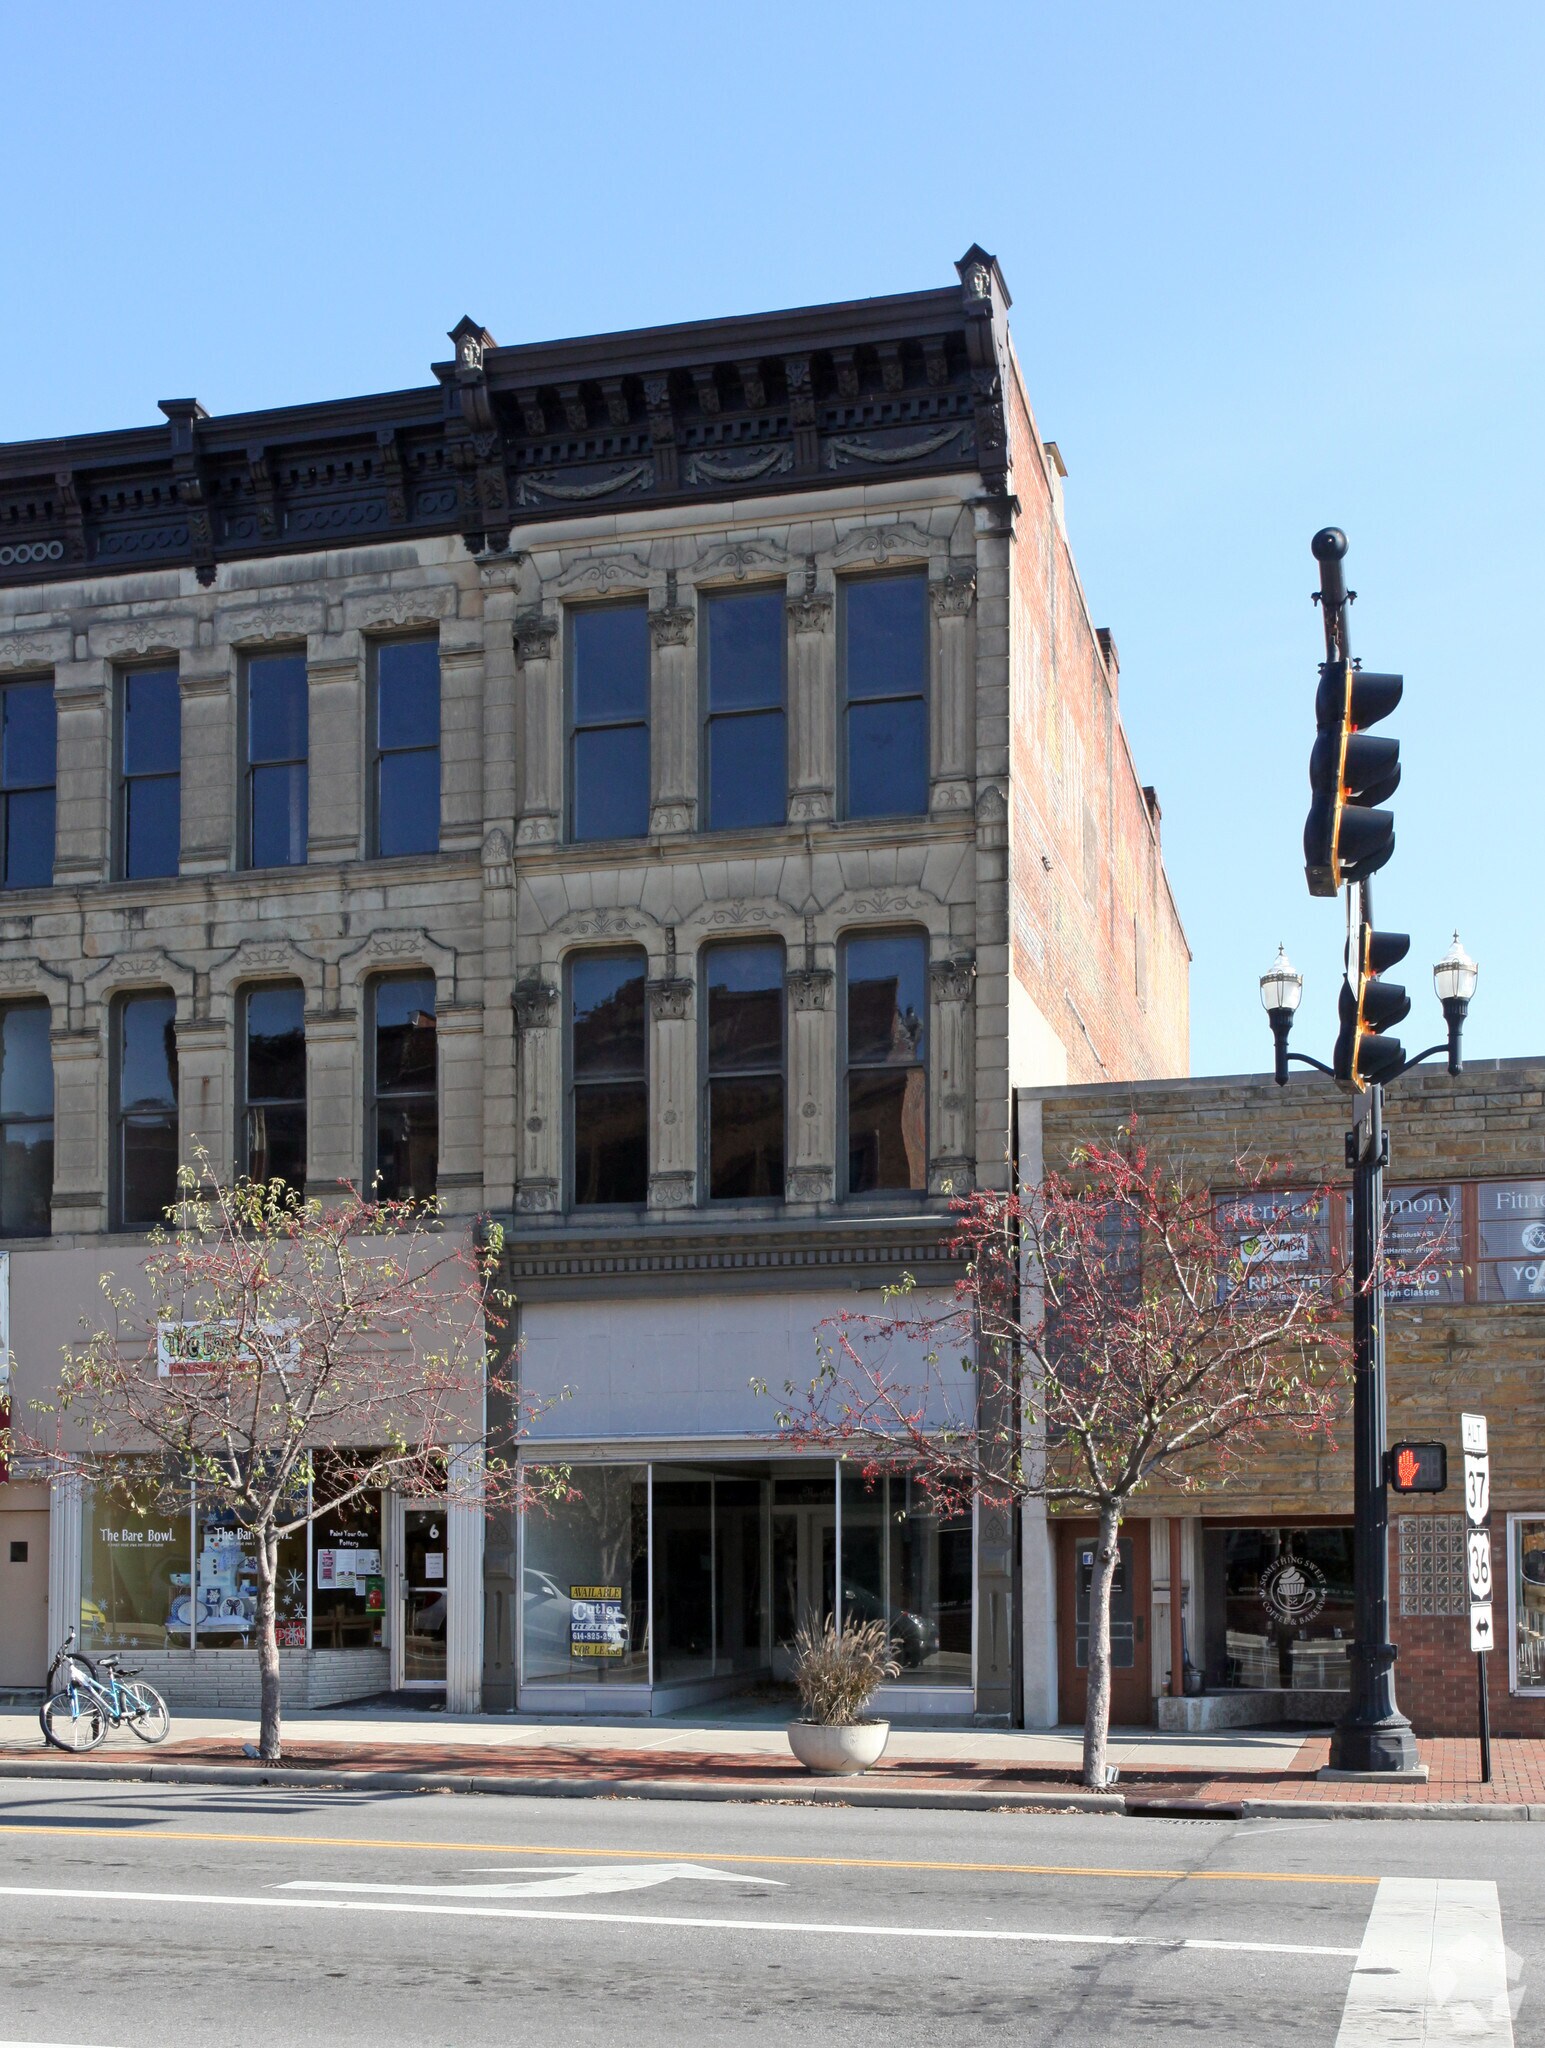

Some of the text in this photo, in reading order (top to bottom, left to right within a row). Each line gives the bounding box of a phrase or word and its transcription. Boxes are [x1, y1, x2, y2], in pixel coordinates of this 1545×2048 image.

[1392, 1230, 1424, 1239] Sandusk
[1403, 1288, 1440, 1297] Classes
[1467, 1424, 1481, 1443] ALT
[1468, 1471, 1486, 1508] 37
[100, 1528, 119, 1541] The
[122, 1529, 143, 1541] Bare
[214, 1527, 234, 1540] The
[237, 1527, 255, 1540] Bar
[329, 1529, 343, 1537] Paint
[357, 1530, 369, 1538] Own
[429, 1524, 439, 1539] 6
[339, 1538, 359, 1548] Pottery
[1260, 1553, 1327, 1586] SOMETHING SWEET
[1472, 1546, 1488, 1584] 36
[573, 1587, 620, 1597] AVAILABLE
[572, 1602, 621, 1620] Cutler
[1262, 1597, 1326, 1626] COFFEE & BAKERY
[574, 1645, 590, 1655] FOR
